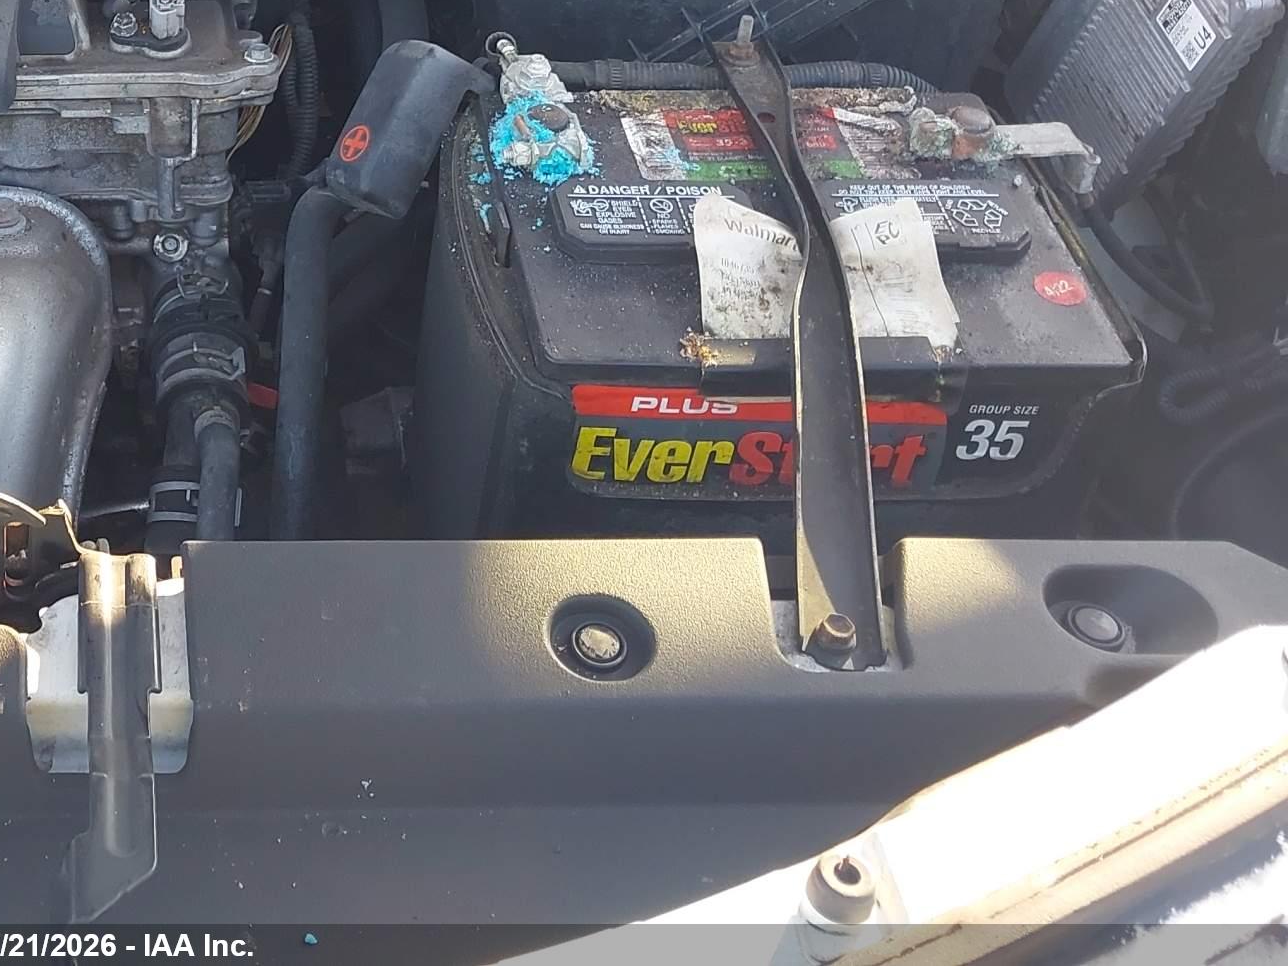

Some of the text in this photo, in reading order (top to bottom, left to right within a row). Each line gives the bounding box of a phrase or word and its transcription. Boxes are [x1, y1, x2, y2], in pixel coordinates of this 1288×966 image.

[1193, 25, 1212, 50] U4
[588, 185, 722, 196] DANGER / POISON
[611, 199, 638, 207] SHIELD
[631, 396, 738, 415] PLUS
[969, 404, 1040, 415] GROUP SIZE
[955, 419, 1030, 461] 35
[571, 426, 928, 488] EverSt
